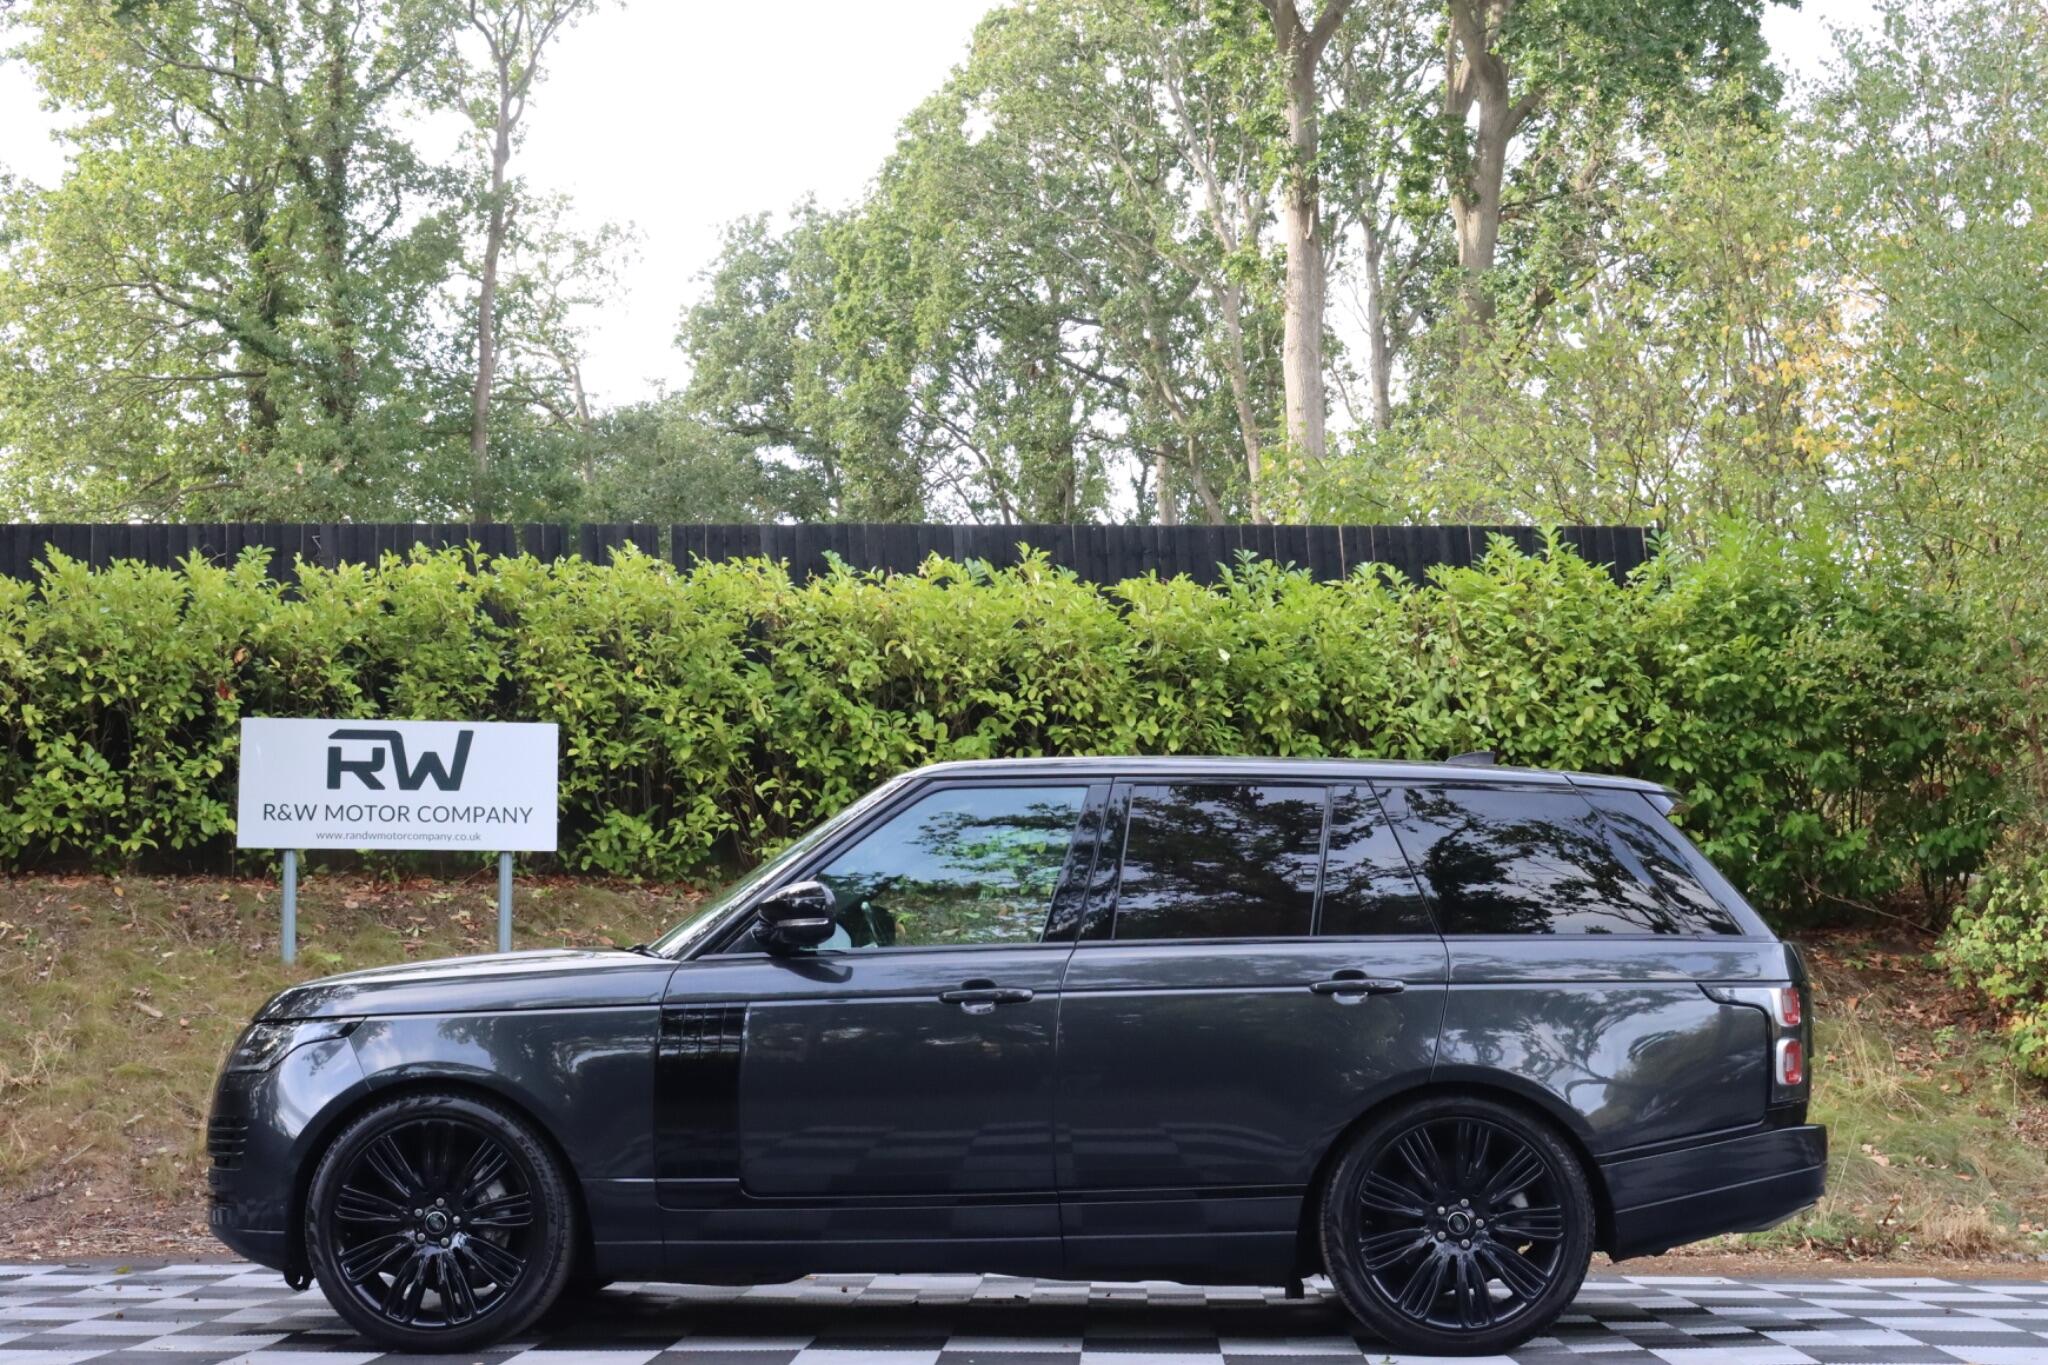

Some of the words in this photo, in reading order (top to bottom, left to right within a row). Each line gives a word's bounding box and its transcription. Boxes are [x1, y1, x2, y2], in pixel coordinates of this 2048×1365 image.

[327, 729, 474, 791] RW
[263, 803, 317, 821] R&W
[325, 804, 410, 823] MOTOR
[417, 805, 533, 824] COMPANY
[316, 831, 481, 842] www.randwmotorcompany.co.uk
